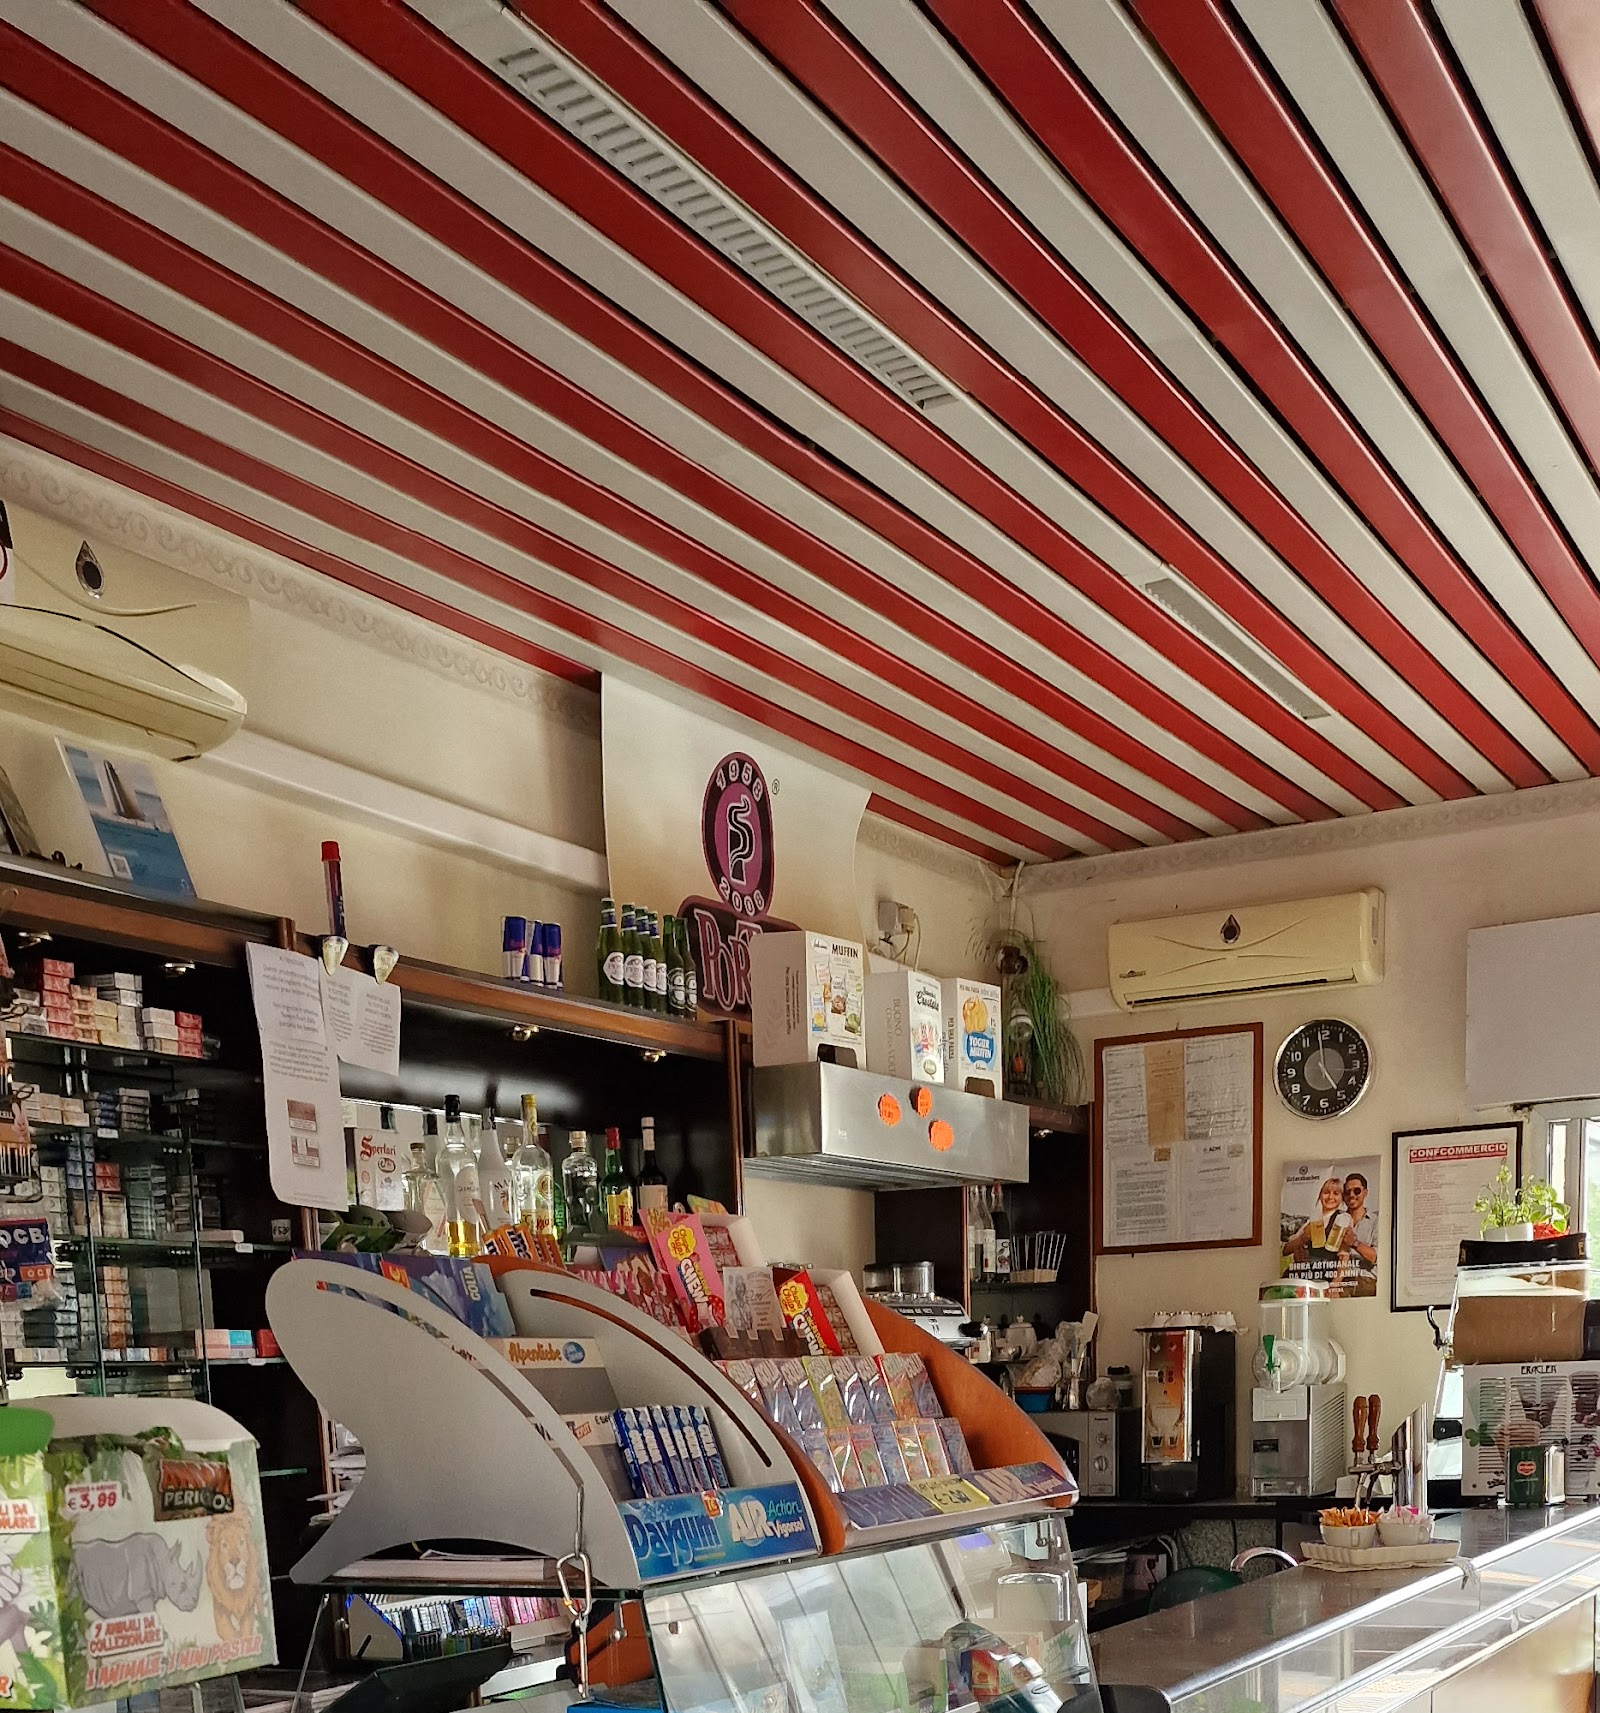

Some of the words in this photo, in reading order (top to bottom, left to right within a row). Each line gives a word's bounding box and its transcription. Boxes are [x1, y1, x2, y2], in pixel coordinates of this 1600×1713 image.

[715, 759, 764, 802] 1958
[718, 876, 765, 917] 2008
[831, 943, 859, 959] MUFFIN
[1301, 1037, 1311, 1048] 11
[1338, 1032, 1343, 1043] 1
[1290, 1051, 1303, 1062] 10
[1347, 1044, 1358, 1055] 2
[1286, 1068, 1297, 1079] 9
[1351, 1060, 1361, 1071] 3
[1291, 1083, 1301, 1094] 8
[1347, 1075, 1357, 1086] 4
[1302, 1095, 1312, 1106] 7
[1319, 1098, 1330, 1109] 6
[1336, 1090, 1347, 1101] 5
[360, 1134, 397, 1162] Sperlari
[1410, 1142, 1508, 1158] CONFCOMMERCIO
[670, 1230, 684, 1256] Chups
[679, 1227, 691, 1254] Chupa
[1288, 1261, 1312, 1271] BIRRA
[1312, 1260, 1361, 1270] ARTIGIANALE
[680, 1257, 710, 1304] CHEW
[1301, 1269, 1314, 1279] PIÙ
[1314, 1271, 1323, 1279] DI
[1324, 1270, 1338, 1279] 400
[462, 1266, 481, 1301] GOLIA
[508, 1342, 562, 1365] Alpenliebe
[728, 1500, 774, 1543] AIR
[766, 1499, 802, 1518] Action
[769, 1516, 807, 1538] Vigorsol
[622, 1513, 724, 1568] Daygum
[105, 1617, 141, 1635] ANIMALI
[143, 1614, 155, 1629] DA
[89, 1628, 162, 1654] COLLEZIONARE
